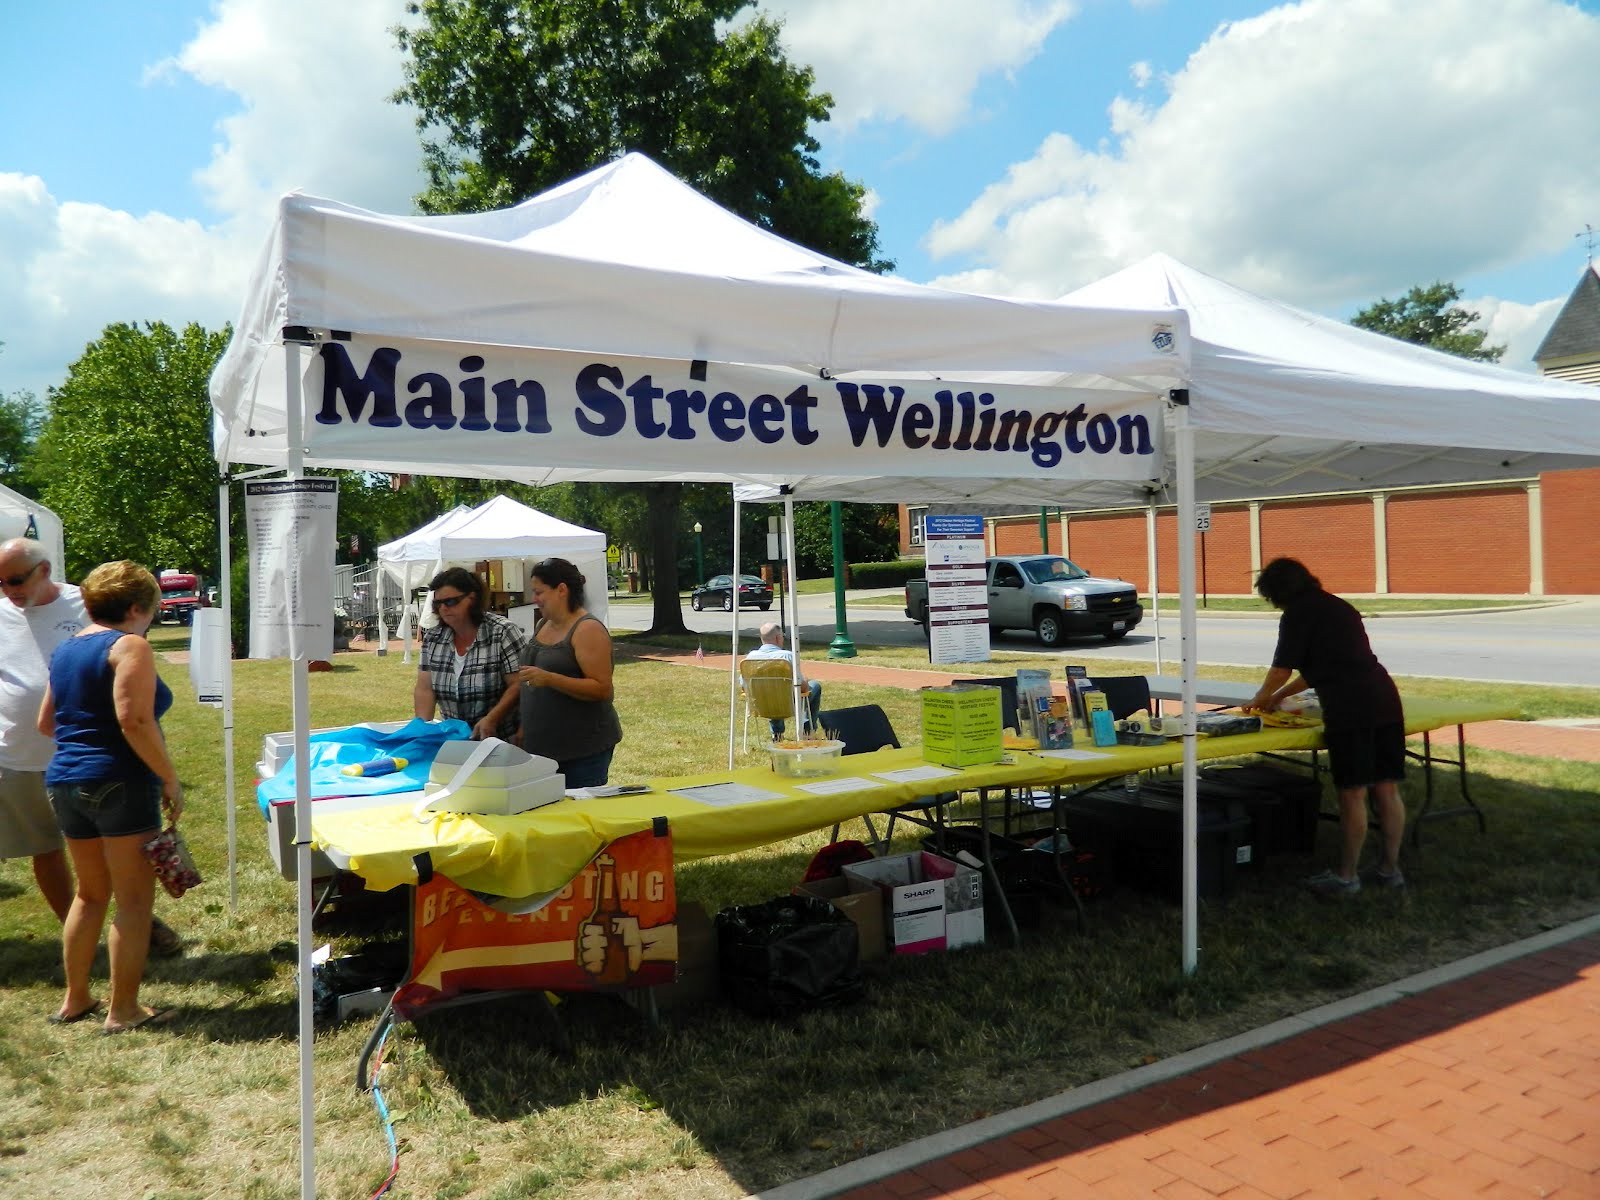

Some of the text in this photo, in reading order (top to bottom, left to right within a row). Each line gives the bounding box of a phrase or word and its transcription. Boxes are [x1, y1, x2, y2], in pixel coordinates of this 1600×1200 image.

[315, 342, 1154, 468] Main Street Wellington
[1197, 518, 1209, 528] 25
[903, 888, 936, 899] SHARP
